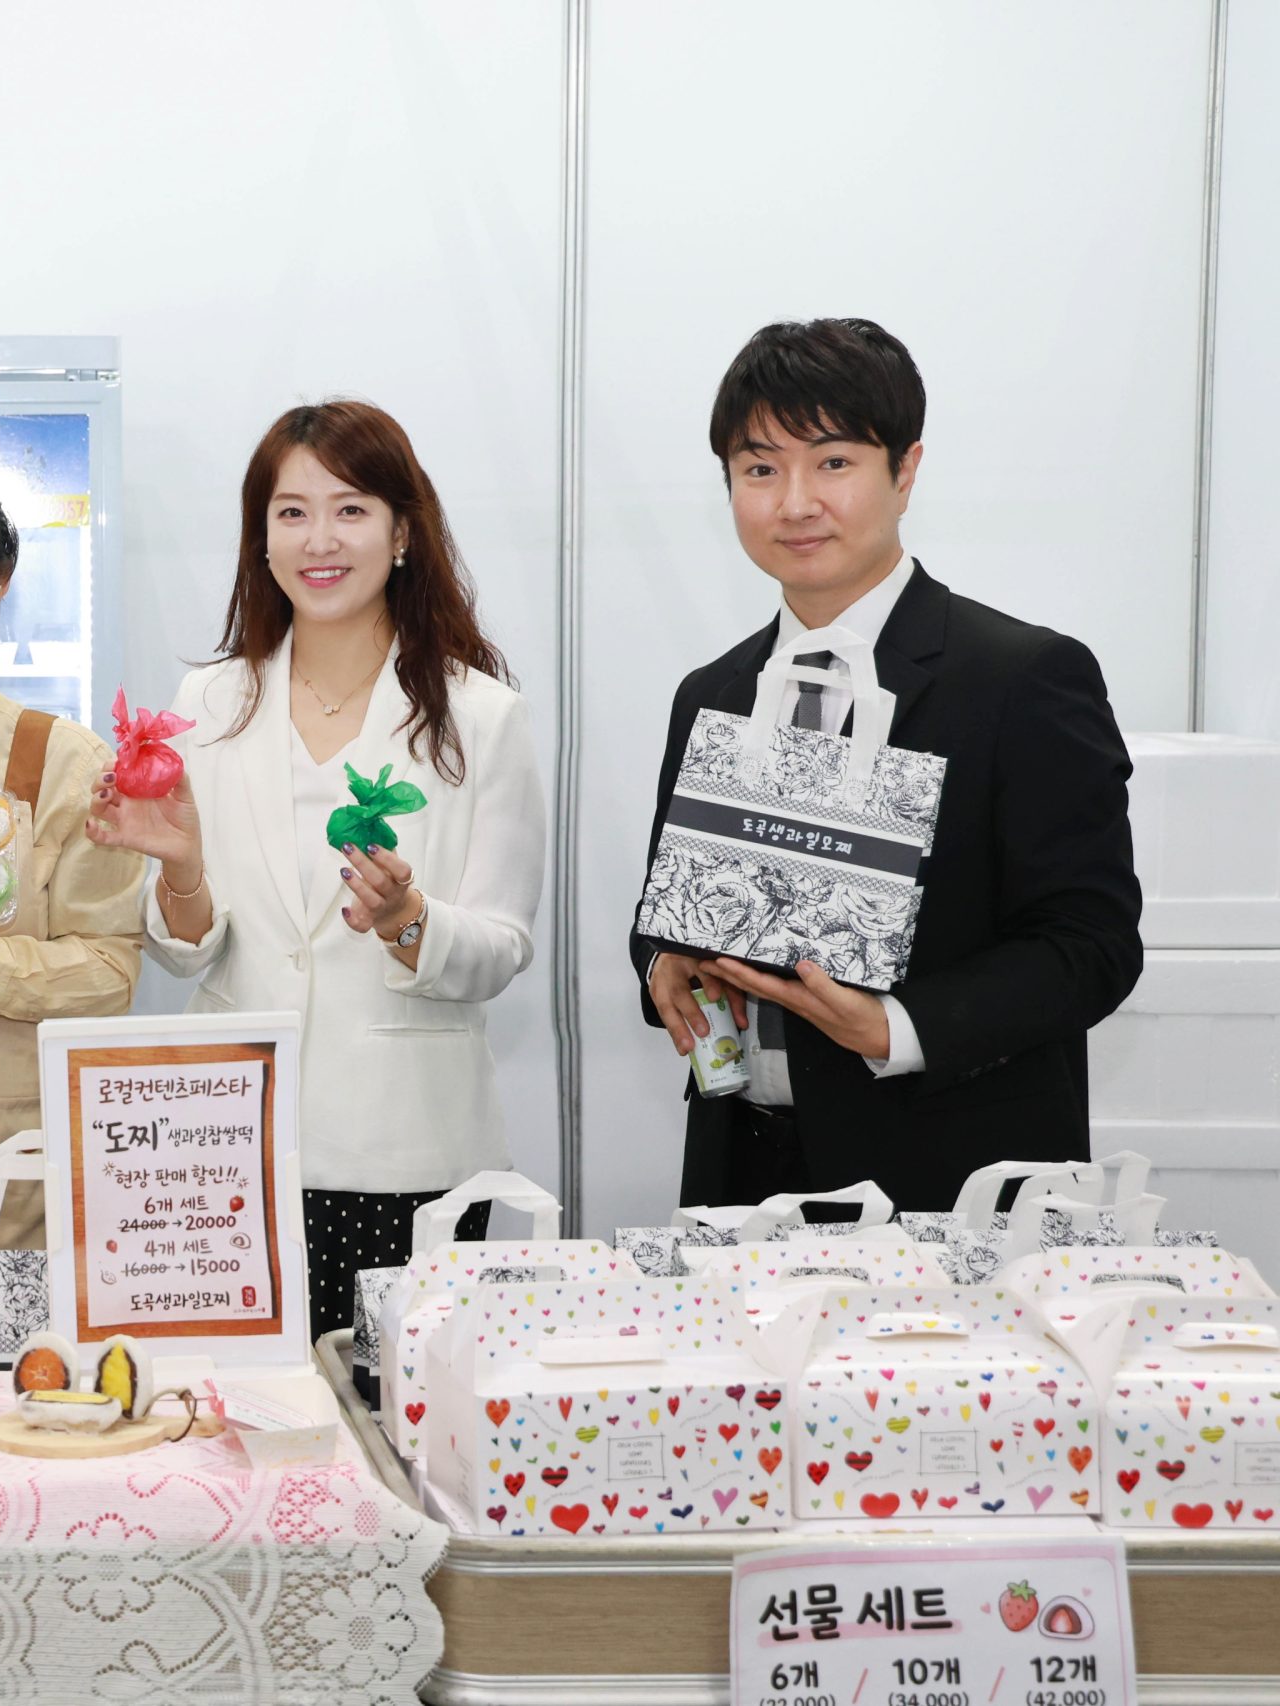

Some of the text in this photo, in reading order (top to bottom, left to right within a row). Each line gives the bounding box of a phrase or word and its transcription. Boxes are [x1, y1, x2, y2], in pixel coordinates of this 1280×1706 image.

[743, 817, 852, 855] 도곡생과일모찌
[99, 1075, 252, 1105] 로컬컨텐츠페스타
[168, 1125, 253, 1148] 생과일찹쌀떡
[115, 1164, 239, 1189] 현장 판매 할인!!
[144, 1195, 209, 1214] 6개 세트
[118, 1215, 236, 1233] 24000 20000
[144, 1239, 213, 1257] 4개 세트
[191, 1258, 240, 1276] 15000
[130, 1290, 231, 1312] 도곡생과일모찌
[759, 1583, 953, 1640] 선물 세트
[770, 1655, 1097, 1690] 6개 10개 12개
[888, 1691, 970, 1706] (34000)
